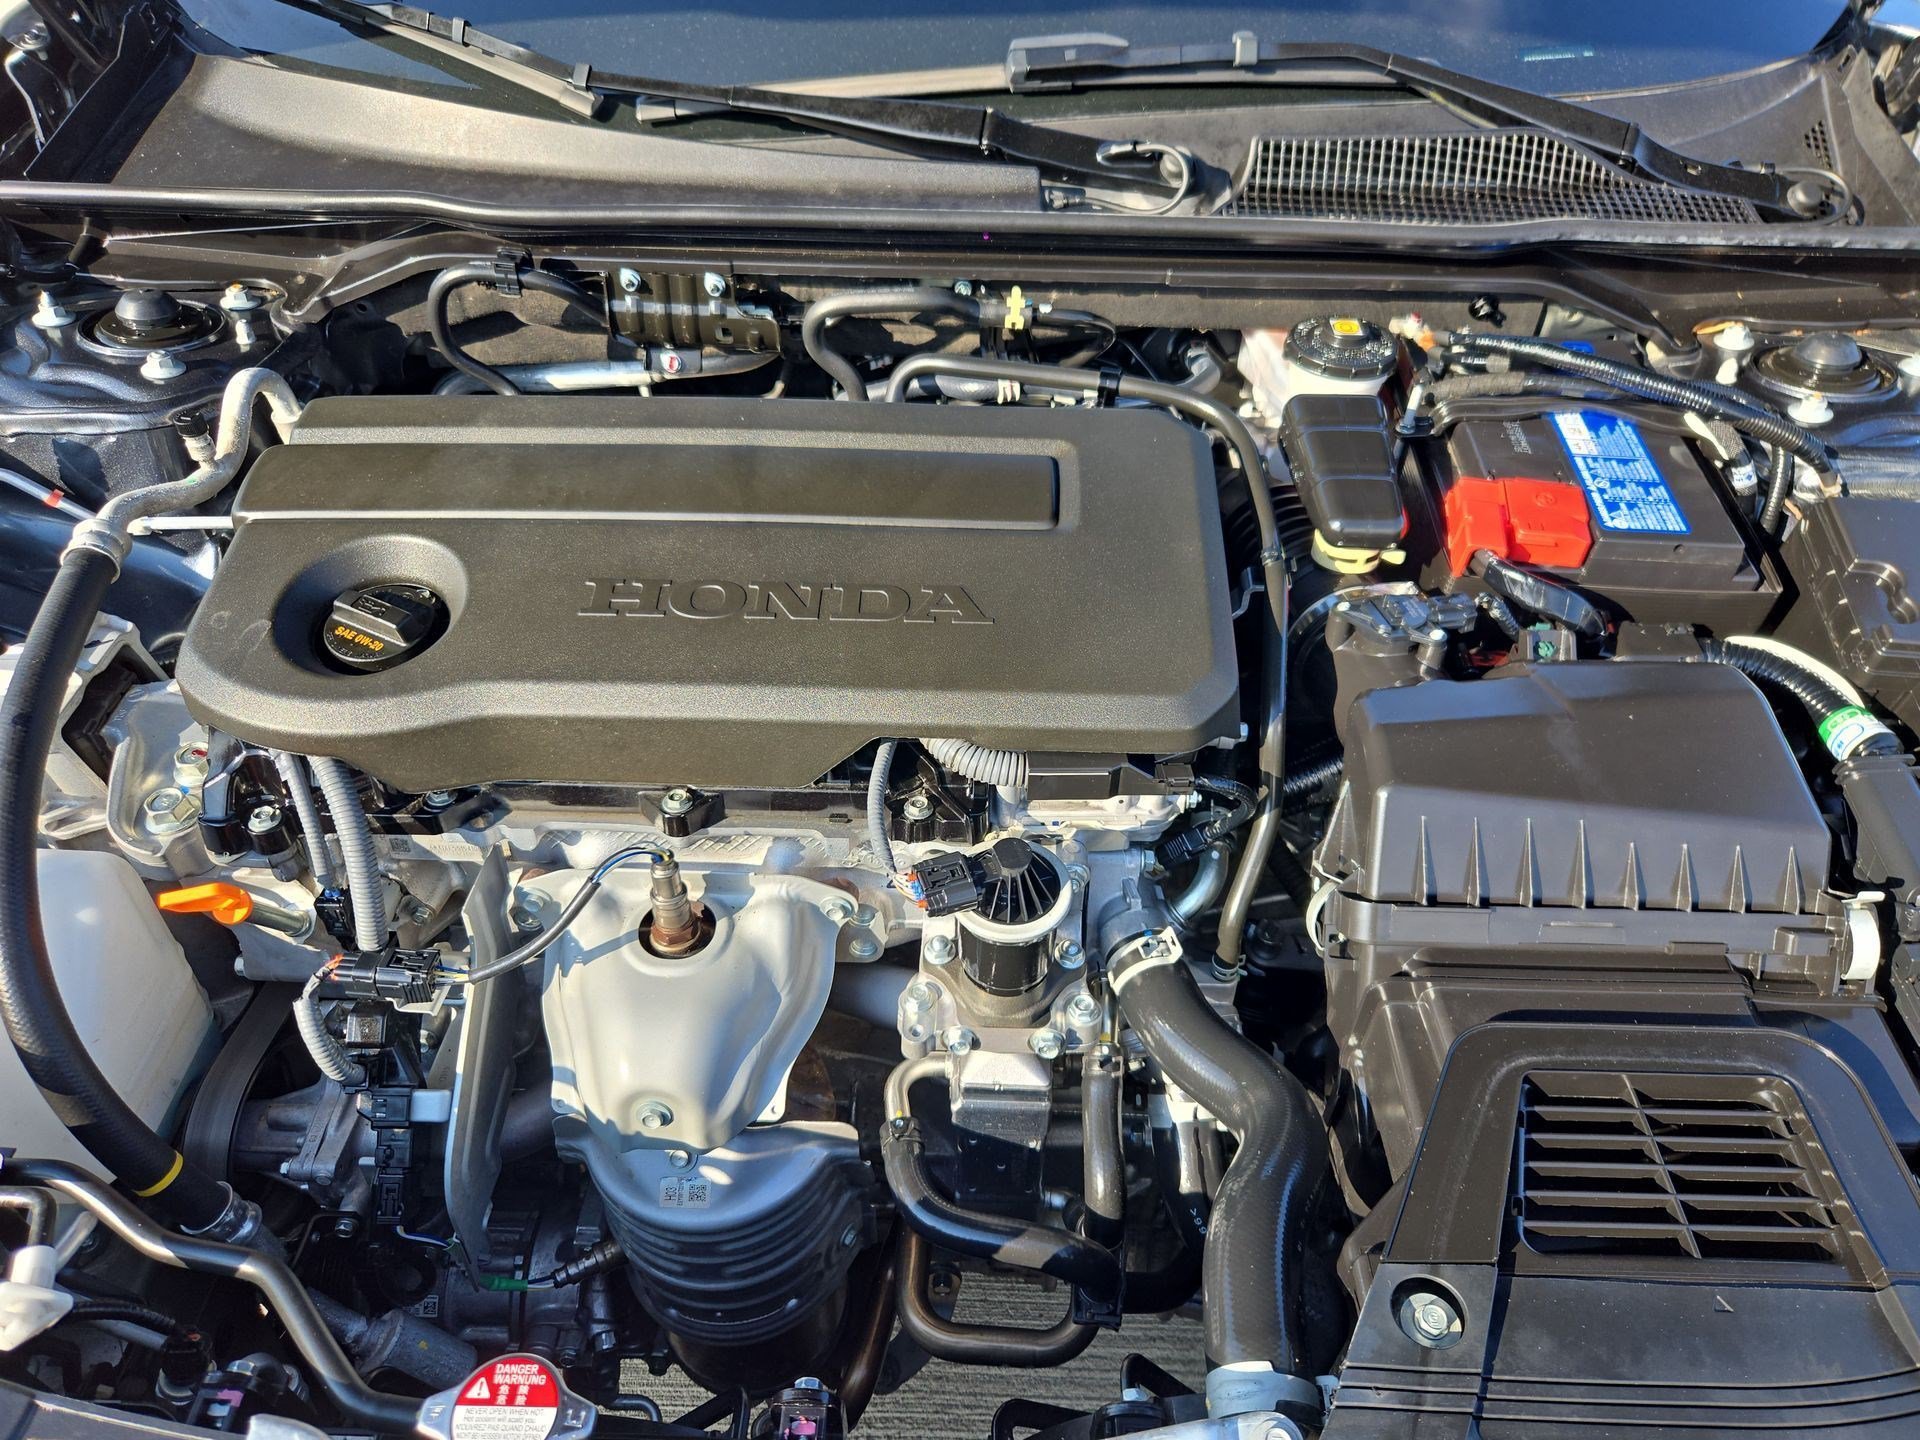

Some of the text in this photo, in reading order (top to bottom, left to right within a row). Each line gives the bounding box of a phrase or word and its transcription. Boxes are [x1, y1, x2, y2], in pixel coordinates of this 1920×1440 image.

[577, 579, 995, 624] HONDA
[335, 626, 357, 641] SAE
[355, 633, 385, 652] 0W-20
[496, 1363, 539, 1374] DANGER
[493, 1374, 547, 1385] WARNUNG
[465, 1407, 487, 1415] NEVER
[509, 1408, 528, 1416] WHEN
